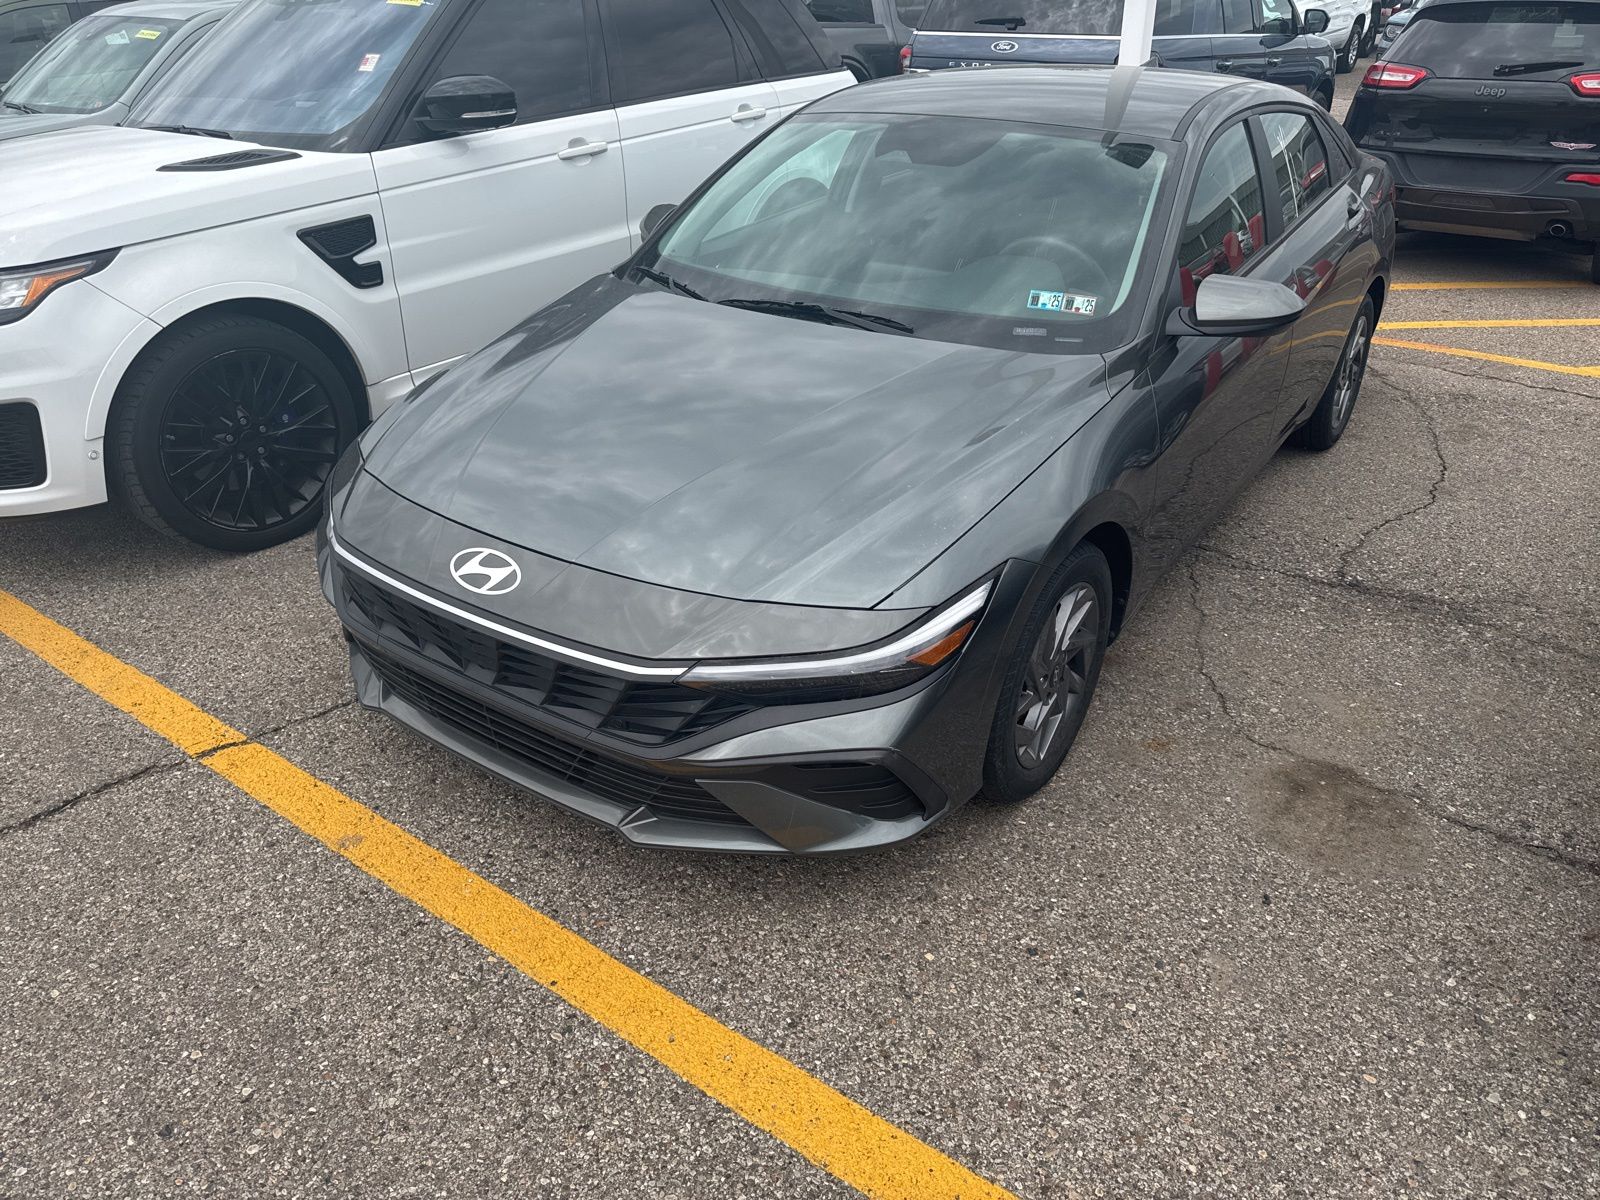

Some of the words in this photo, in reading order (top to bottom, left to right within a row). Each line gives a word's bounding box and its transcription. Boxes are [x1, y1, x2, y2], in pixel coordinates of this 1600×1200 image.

[996, 41, 1012, 50] Ford
[1475, 85, 1506, 98] Jeep
[1051, 294, 1062, 308] 25
[1084, 299, 1095, 312] 25
